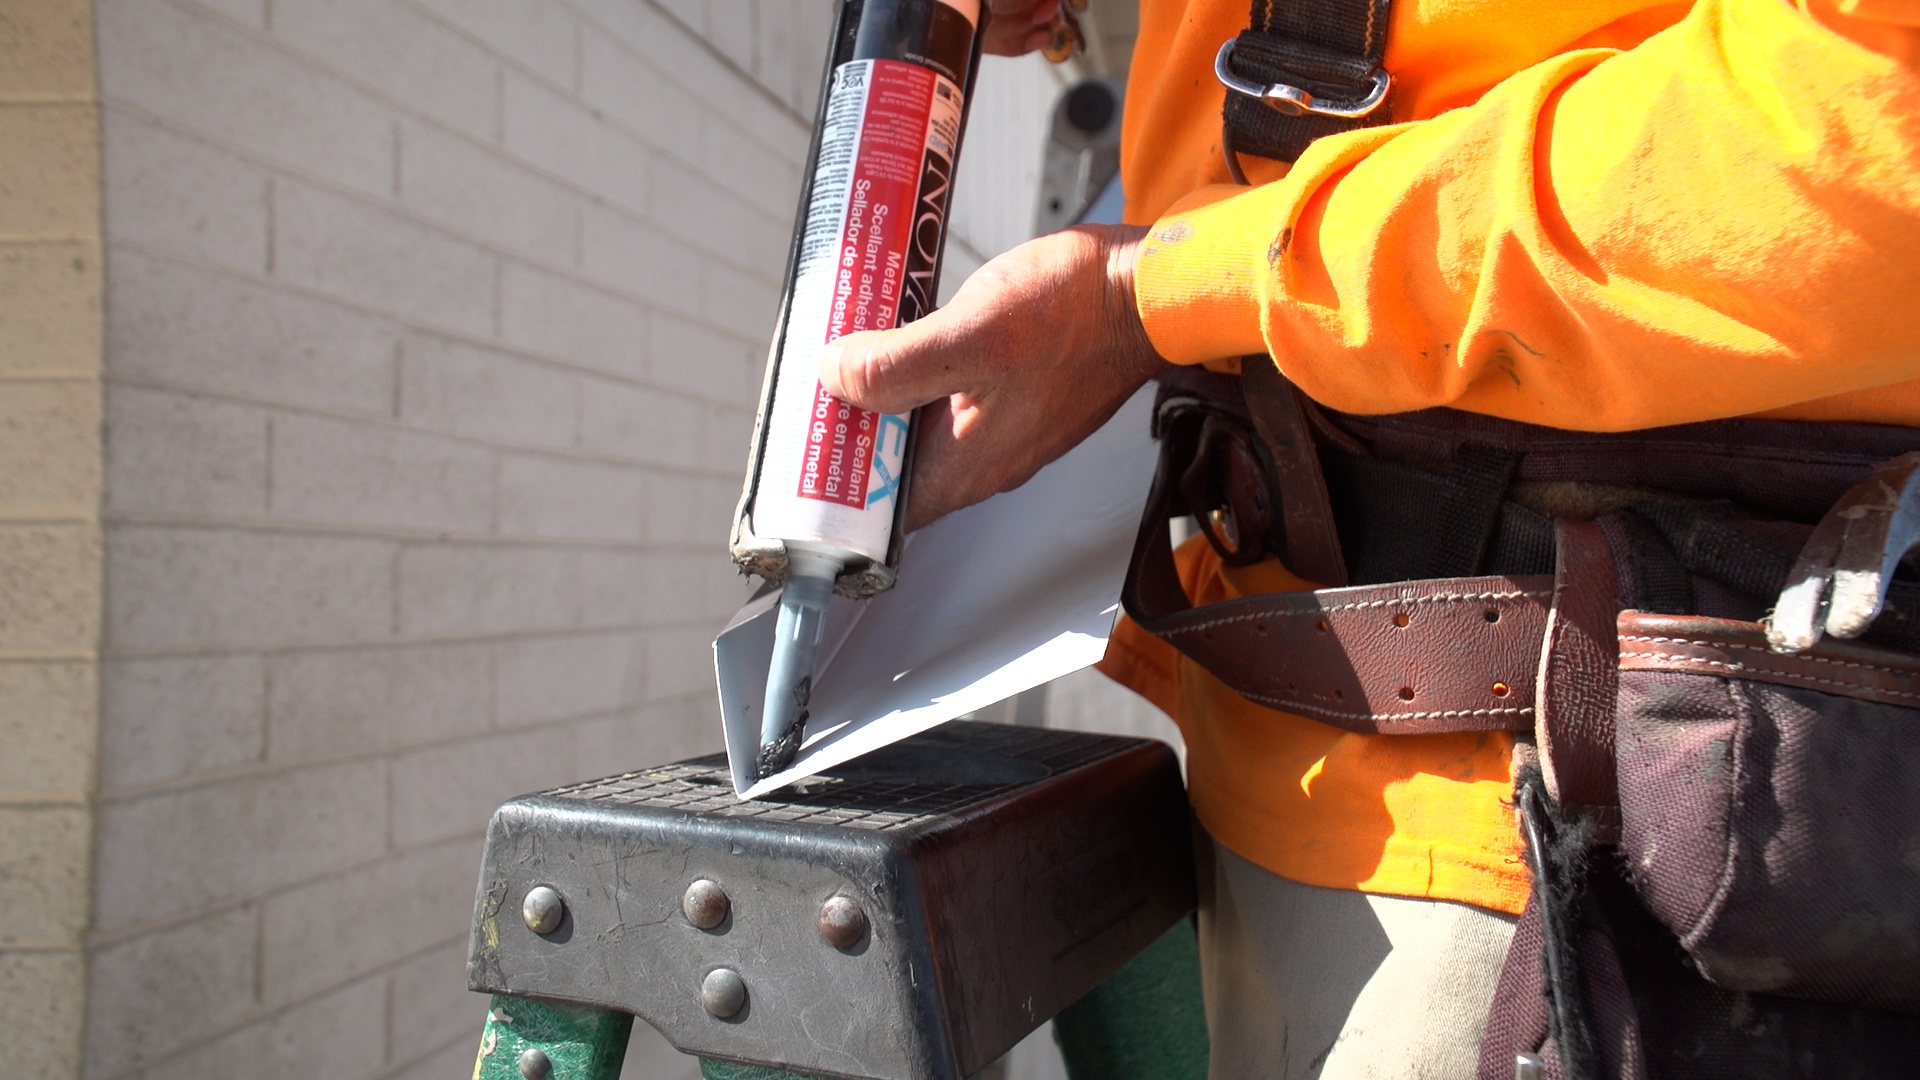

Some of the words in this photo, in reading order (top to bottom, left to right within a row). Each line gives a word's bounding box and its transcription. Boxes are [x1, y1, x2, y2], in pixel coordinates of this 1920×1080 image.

[846, 178, 870, 244] Sellador
[841, 245, 858, 267] de
[862, 202, 888, 271] Scellant
[880, 250, 901, 299] Metal
[852, 273, 875, 332] adhési
[875, 304, 892, 331] Ro
[814, 387, 834, 419] cho
[810, 420, 828, 443] de
[833, 422, 848, 445] en
[801, 443, 823, 494] metal
[824, 448, 846, 497] métal
[846, 433, 871, 503] Sealant
[867, 413, 909, 505] EX
